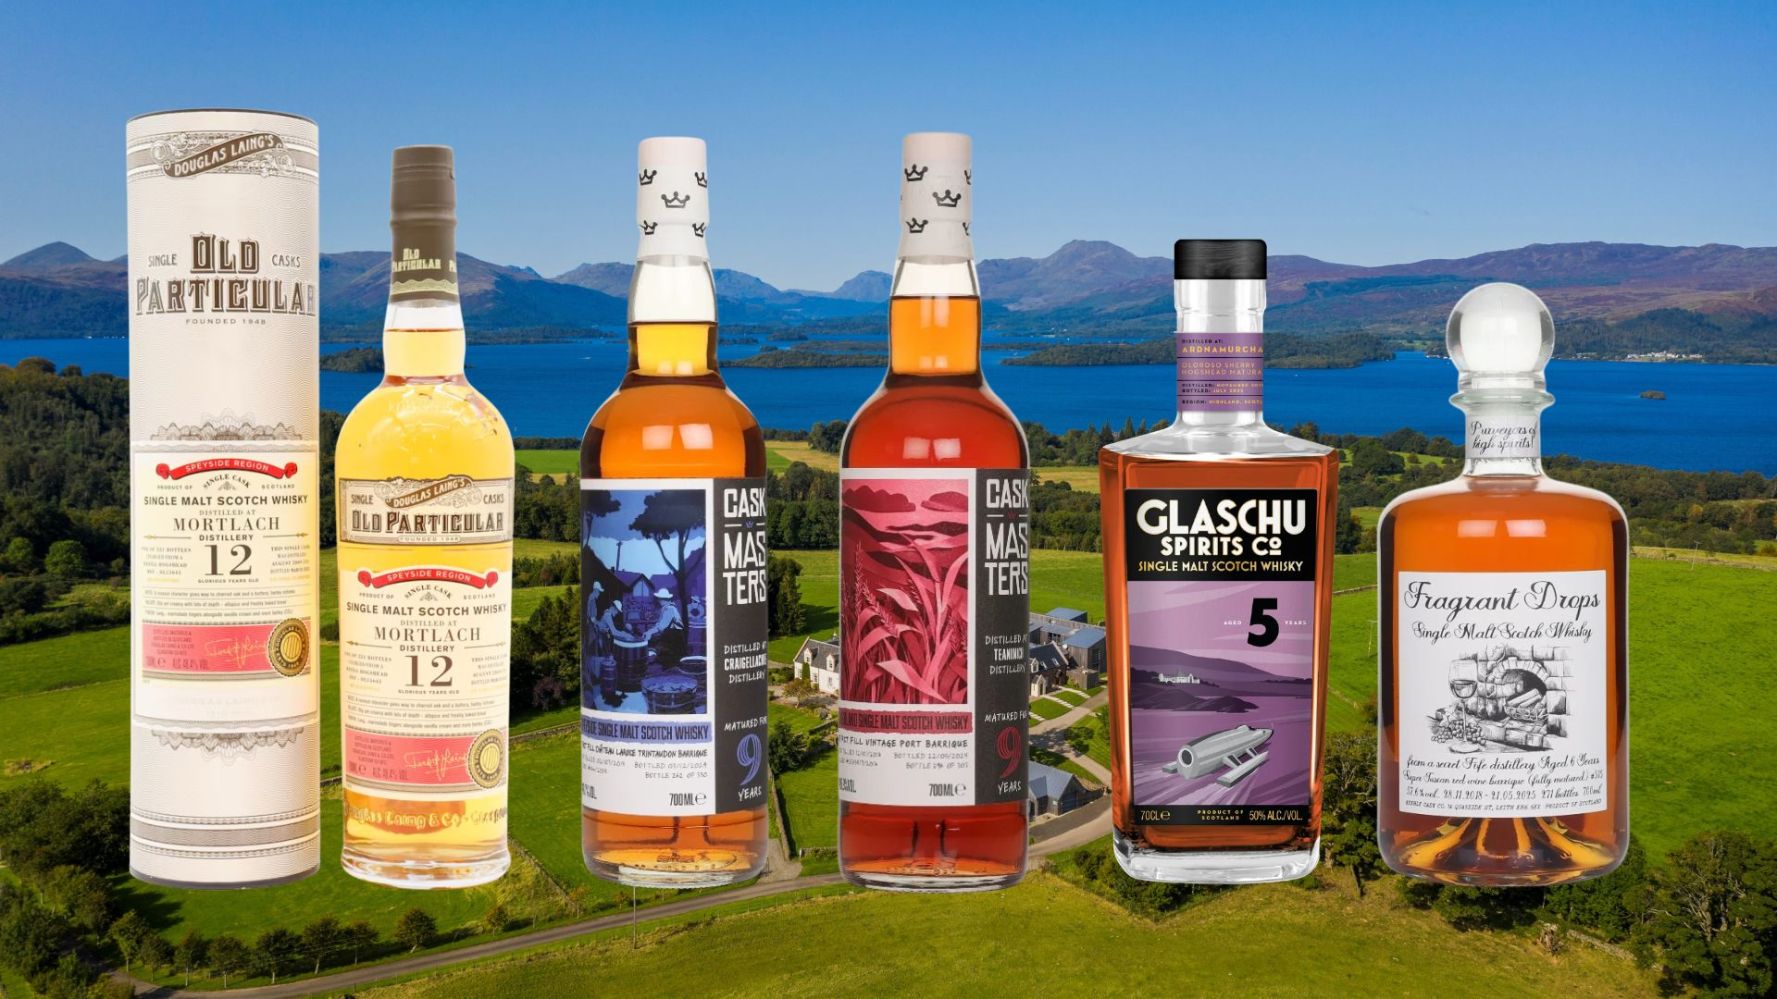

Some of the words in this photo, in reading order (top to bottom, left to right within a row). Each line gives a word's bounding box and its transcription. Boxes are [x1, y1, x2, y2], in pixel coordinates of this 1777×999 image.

[174, 148, 227, 176] DOUGLAS
[231, 134, 275, 156] LAING'S
[148, 254, 177, 267] SINGLE
[190, 232, 260, 274] OLD
[272, 254, 300, 268] CASKS
[136, 276, 316, 316] PARTICULAR
[1472, 435, 1494, 455] high
[185, 460, 230, 472] SPEYSIDE
[234, 460, 269, 472] REGION
[204, 474, 229, 489] SINGLE
[232, 474, 250, 488] CASK
[144, 496, 176, 506] SINGLE
[182, 496, 212, 506] MALT
[217, 496, 268, 506] SCOTCH
[272, 495, 308, 504] WHISKY
[351, 494, 373, 504] SINGLE
[394, 488, 431, 508] DOUGLAS
[434, 478, 466, 495] LAING'S
[483, 494, 504, 504] CASKS
[986, 479, 1028, 508] CASK
[724, 488, 766, 518] CASK
[173, 517, 280, 531] MORTLACH
[352, 510, 382, 532] OLD
[386, 511, 504, 534] PARTICULAR
[1136, 498, 1306, 535] GLASCHU
[199, 534, 254, 542] DISTILLERY
[986, 522, 1028, 560] MAS
[1160, 536, 1243, 556] SPIRITS
[724, 531, 766, 569] MAS
[204, 544, 252, 576] 12
[1138, 561, 1178, 572] SINGLE
[1182, 561, 1208, 572] MALT
[1212, 561, 1257, 572] SCOTCH
[1260, 561, 1304, 572] WHISKY
[387, 570, 432, 582] SPEYSIDE
[436, 570, 471, 582] REGION
[985, 562, 1028, 596] TERS
[404, 585, 431, 599] SINGLE
[434, 585, 452, 599] CASK
[723, 569, 766, 606] TERS
[346, 602, 378, 614] SINGLE
[383, 606, 413, 616] MALT
[418, 606, 469, 616] SCOTCH
[473, 603, 507, 614] WHISKY
[1404, 580, 1520, 622] Fragrant
[1524, 580, 1600, 620] Drops
[1247, 598, 1280, 647] 5
[374, 626, 480, 642] MORTLACH
[986, 634, 1021, 645] DISTILLED
[1412, 622, 1450, 644] Single
[1454, 622, 1497, 639] Malt
[1499, 622, 1544, 639] Scotch
[1545, 622, 1592, 643] Whisky
[724, 642, 760, 654] DISTILLED
[405, 655, 453, 687] 12
[881, 715, 900, 730] MALT
[902, 716, 932, 730] SCOTCH
[936, 716, 968, 730] WHISKY
[984, 711, 1018, 722] MATURED
[598, 722, 618, 738] SINGLE
[620, 724, 639, 739] MALT
[641, 726, 672, 740] SCOTCH
[674, 726, 708, 740] WHISKY
[724, 720, 758, 731] MATURED
[850, 737, 864, 746] FILL
[866, 739, 896, 748] VINTAGE
[900, 740, 922, 748] PORT
[926, 740, 968, 748] BARRIQUE
[678, 749, 708, 758] BARRIQUE
[737, 734, 762, 785] 9
[996, 726, 1022, 778] 9
[1407, 754, 1425, 768] from
[1436, 759, 1460, 769] secret
[1462, 757, 1486, 772] Fife
[1490, 757, 1536, 774] distillery
[1540, 754, 1568, 773] Aged
[1577, 753, 1600, 766] Years
[998, 781, 1022, 796] YEARS
[1452, 774, 1466, 784] red
[1489, 774, 1524, 788] barrique
[738, 786, 762, 802] YEARS
[1555, 787, 1578, 798] bottles
[1250, 810, 1266, 821] 50%
